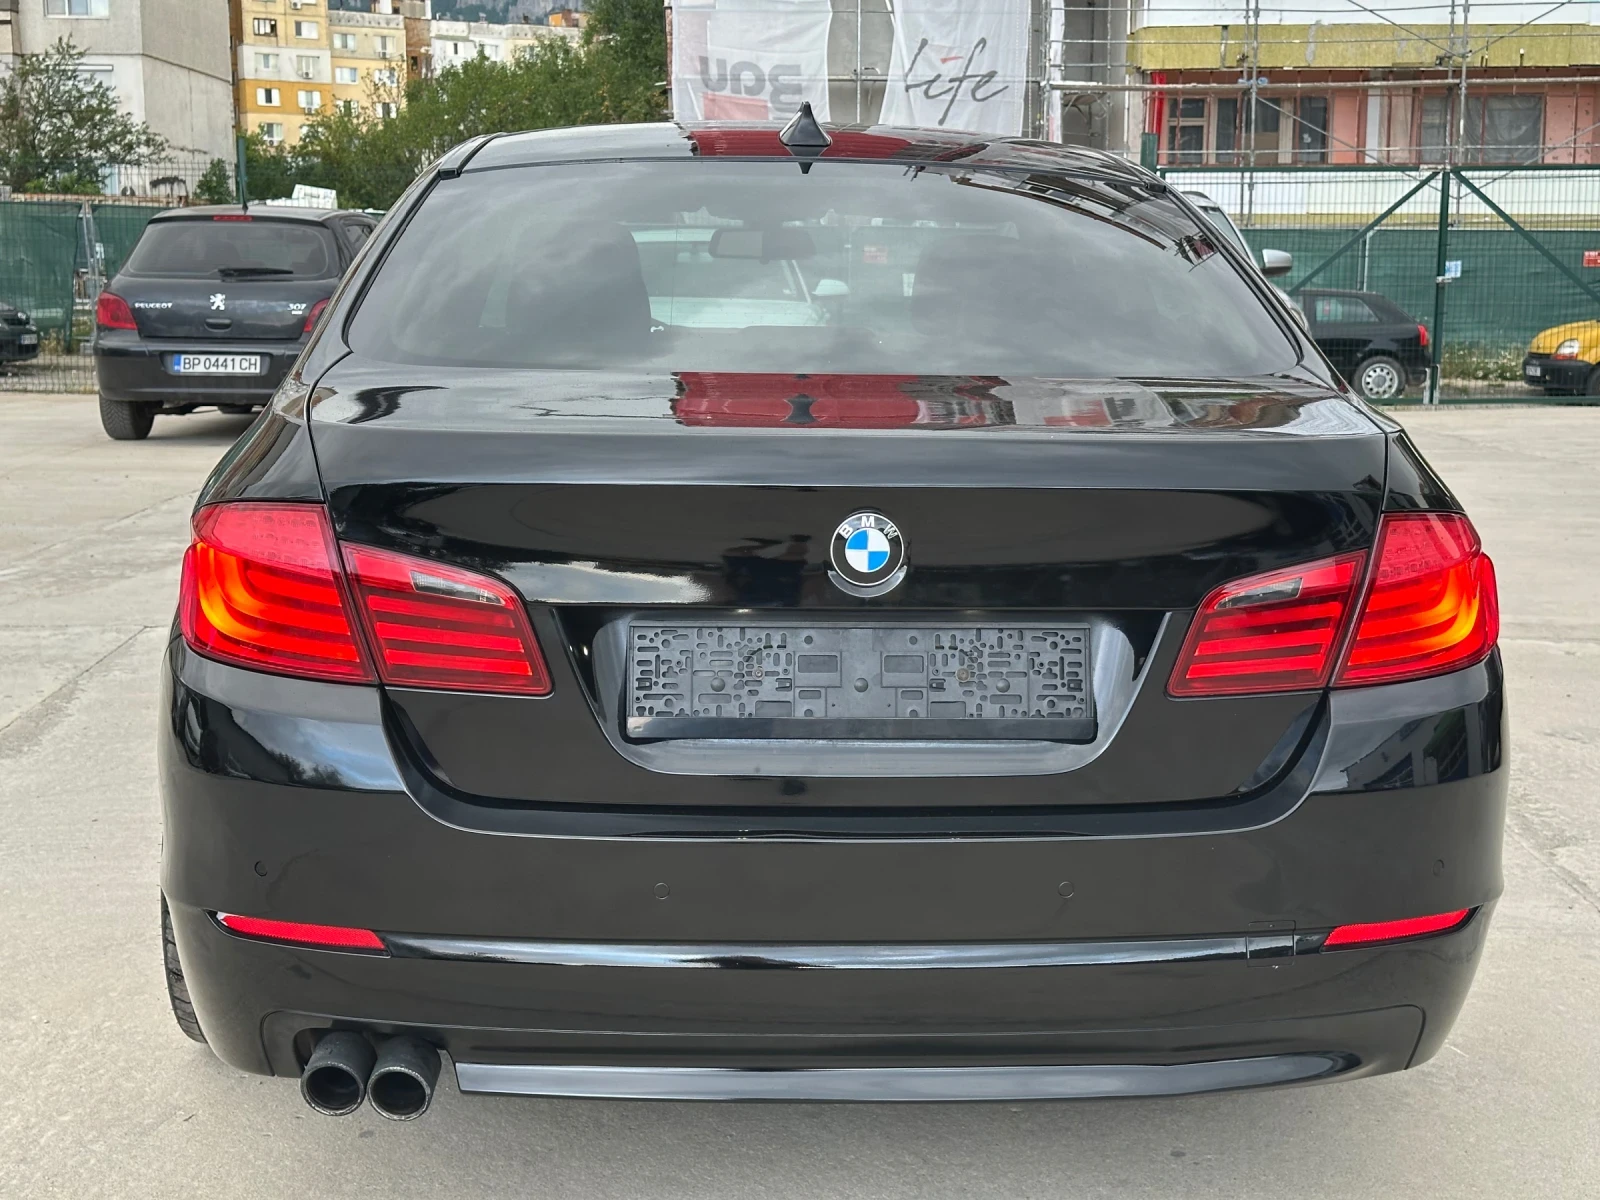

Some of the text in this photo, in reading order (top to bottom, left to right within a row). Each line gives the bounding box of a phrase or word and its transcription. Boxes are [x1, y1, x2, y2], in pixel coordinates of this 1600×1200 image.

[904, 37, 1009, 125] Life
[287, 302, 307, 311] 307
[183, 357, 257, 370] BP 0441 CH
[838, 515, 898, 540] BMW
